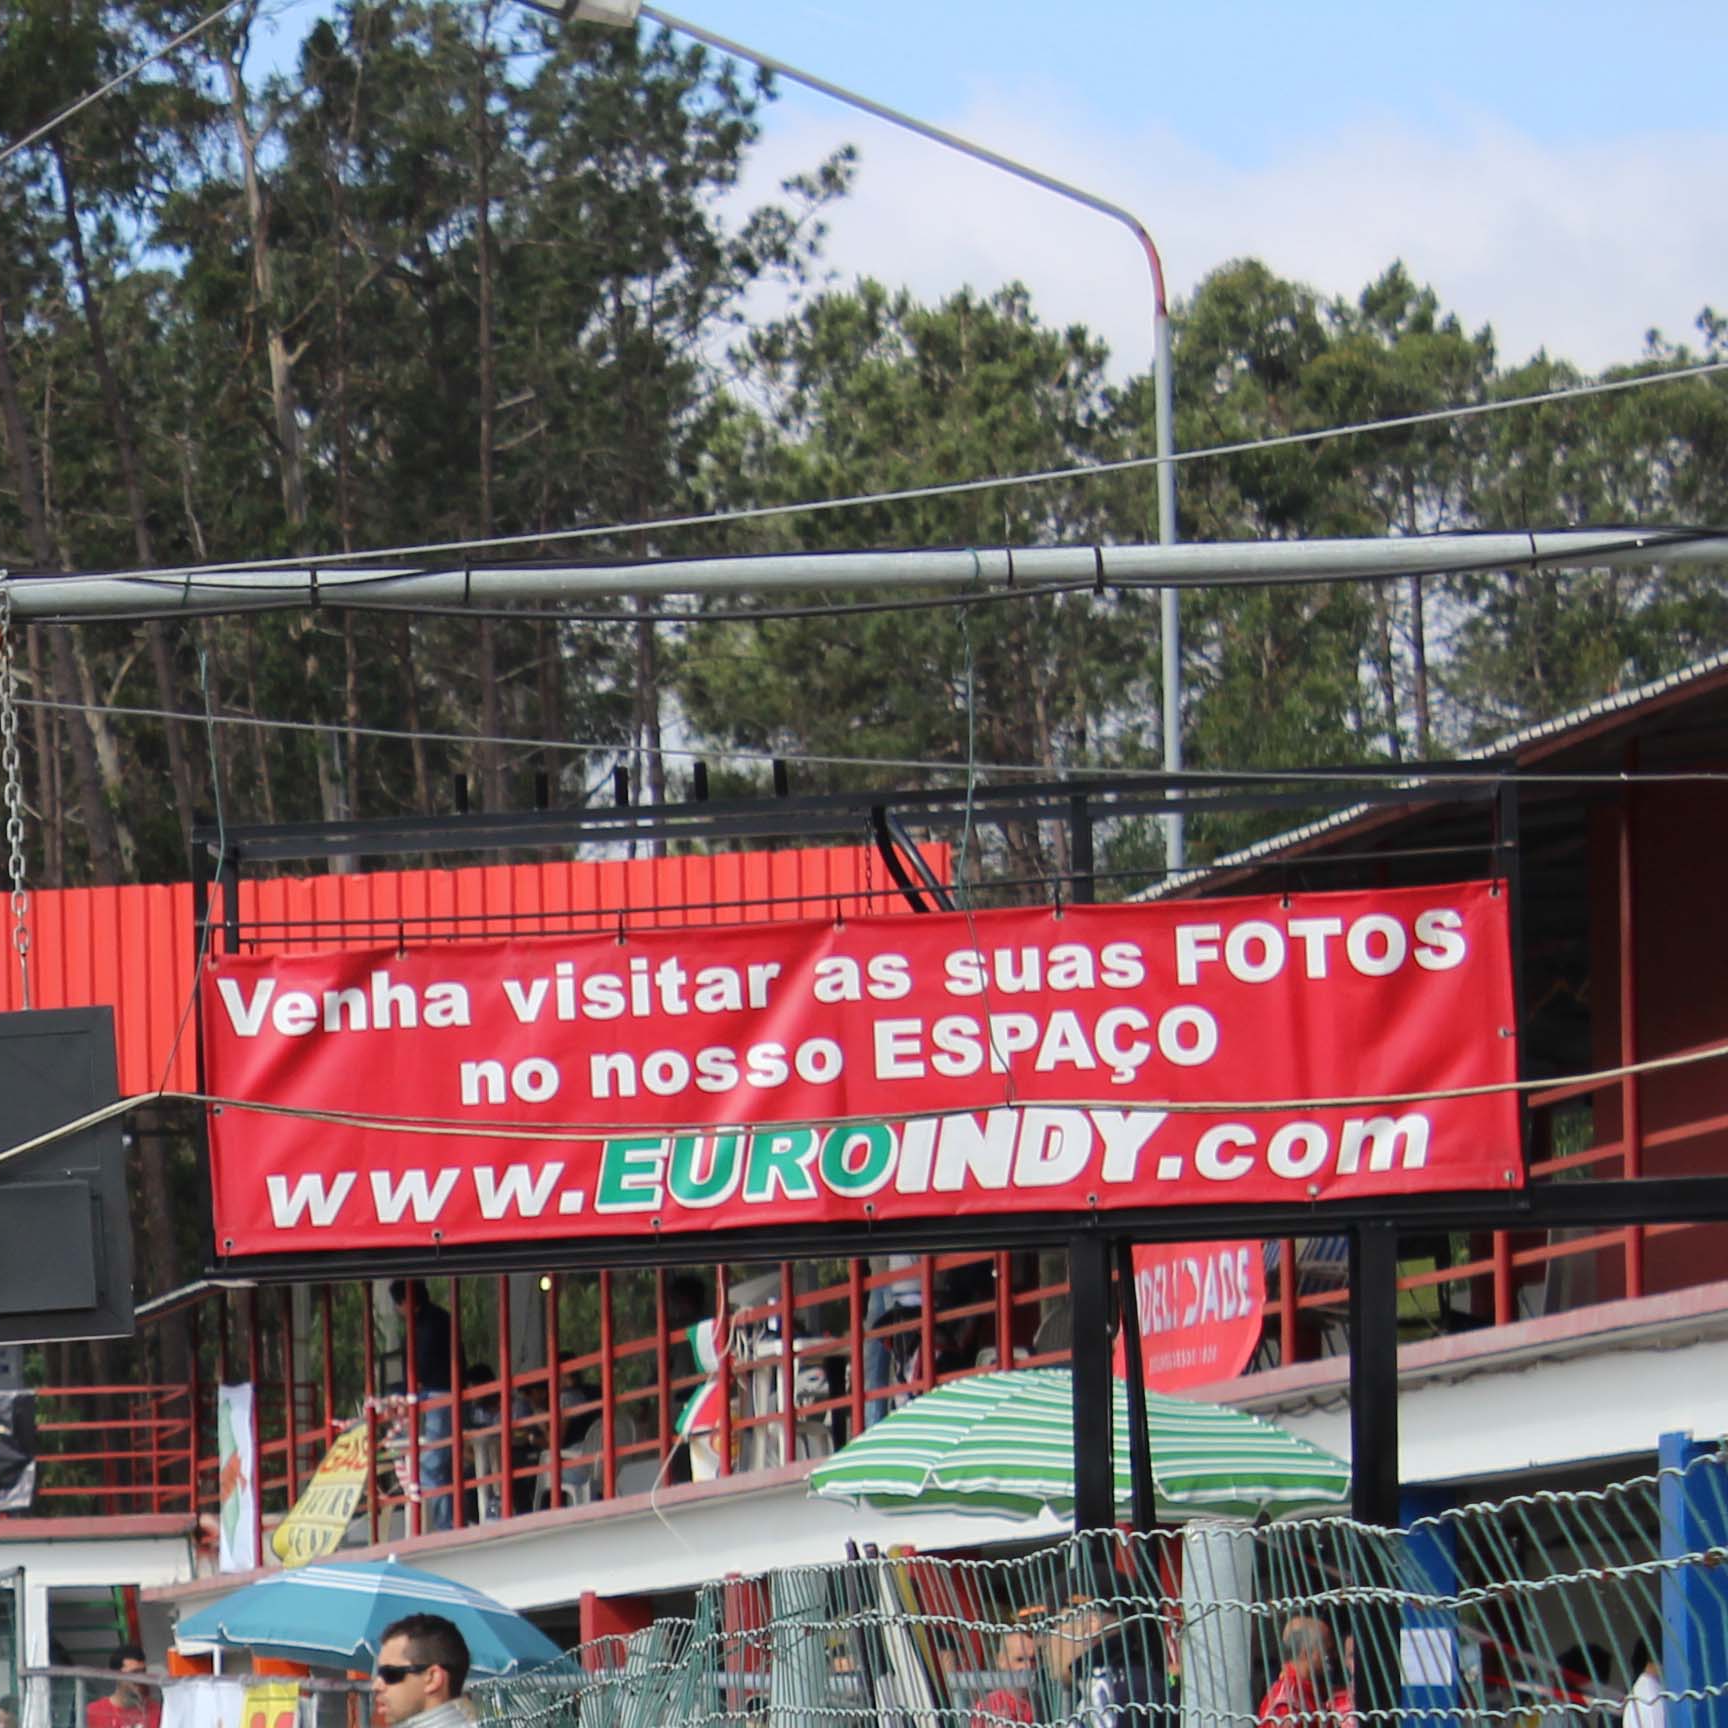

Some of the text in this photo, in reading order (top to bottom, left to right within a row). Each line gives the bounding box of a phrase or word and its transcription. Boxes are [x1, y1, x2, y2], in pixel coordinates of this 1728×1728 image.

[217, 908, 1467, 1037] Venha visitar as suas FOTOS
[459, 1006, 1218, 1106] no nosso ESPAÇO
[266, 1106, 1431, 1228] www.EUROINDY.com
[1134, 1247, 1252, 1337] DELIDADE
